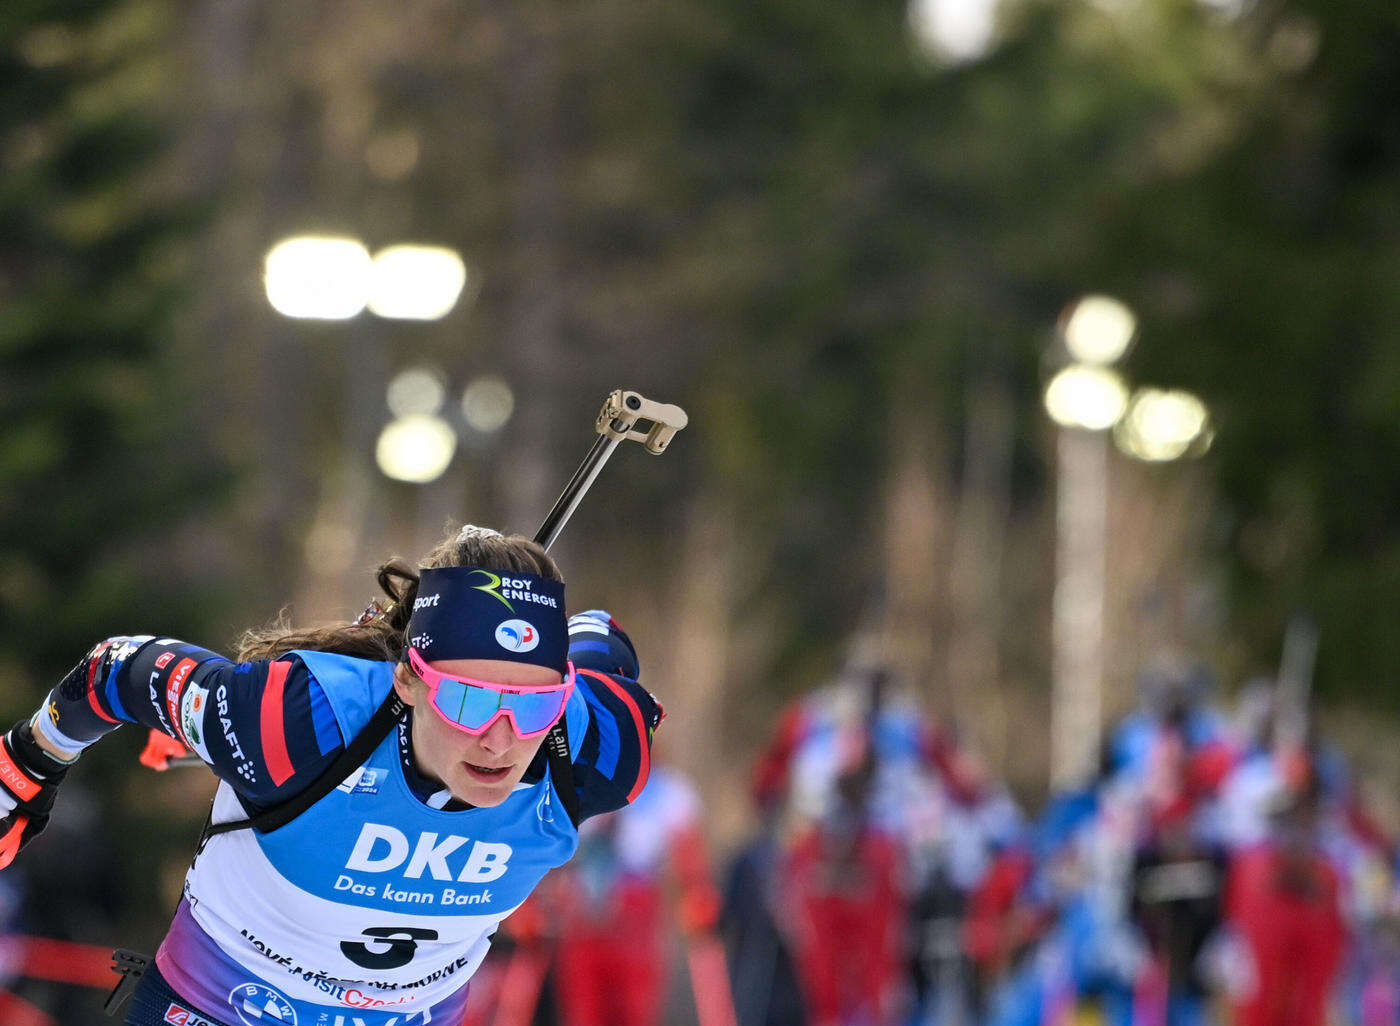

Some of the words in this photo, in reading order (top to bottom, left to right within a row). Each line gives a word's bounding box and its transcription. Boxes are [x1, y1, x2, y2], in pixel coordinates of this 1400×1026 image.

[502, 577, 532, 590] ROY
[502, 589, 558, 608] ENERGIE
[216, 685, 246, 760] CRAFT
[345, 822, 513, 883] DKB
[333, 875, 377, 897] Das
[382, 883, 435, 904] kann
[441, 888, 493, 905] Bank
[340, 927, 438, 970] 3
[245, 986, 292, 1017] BMW
